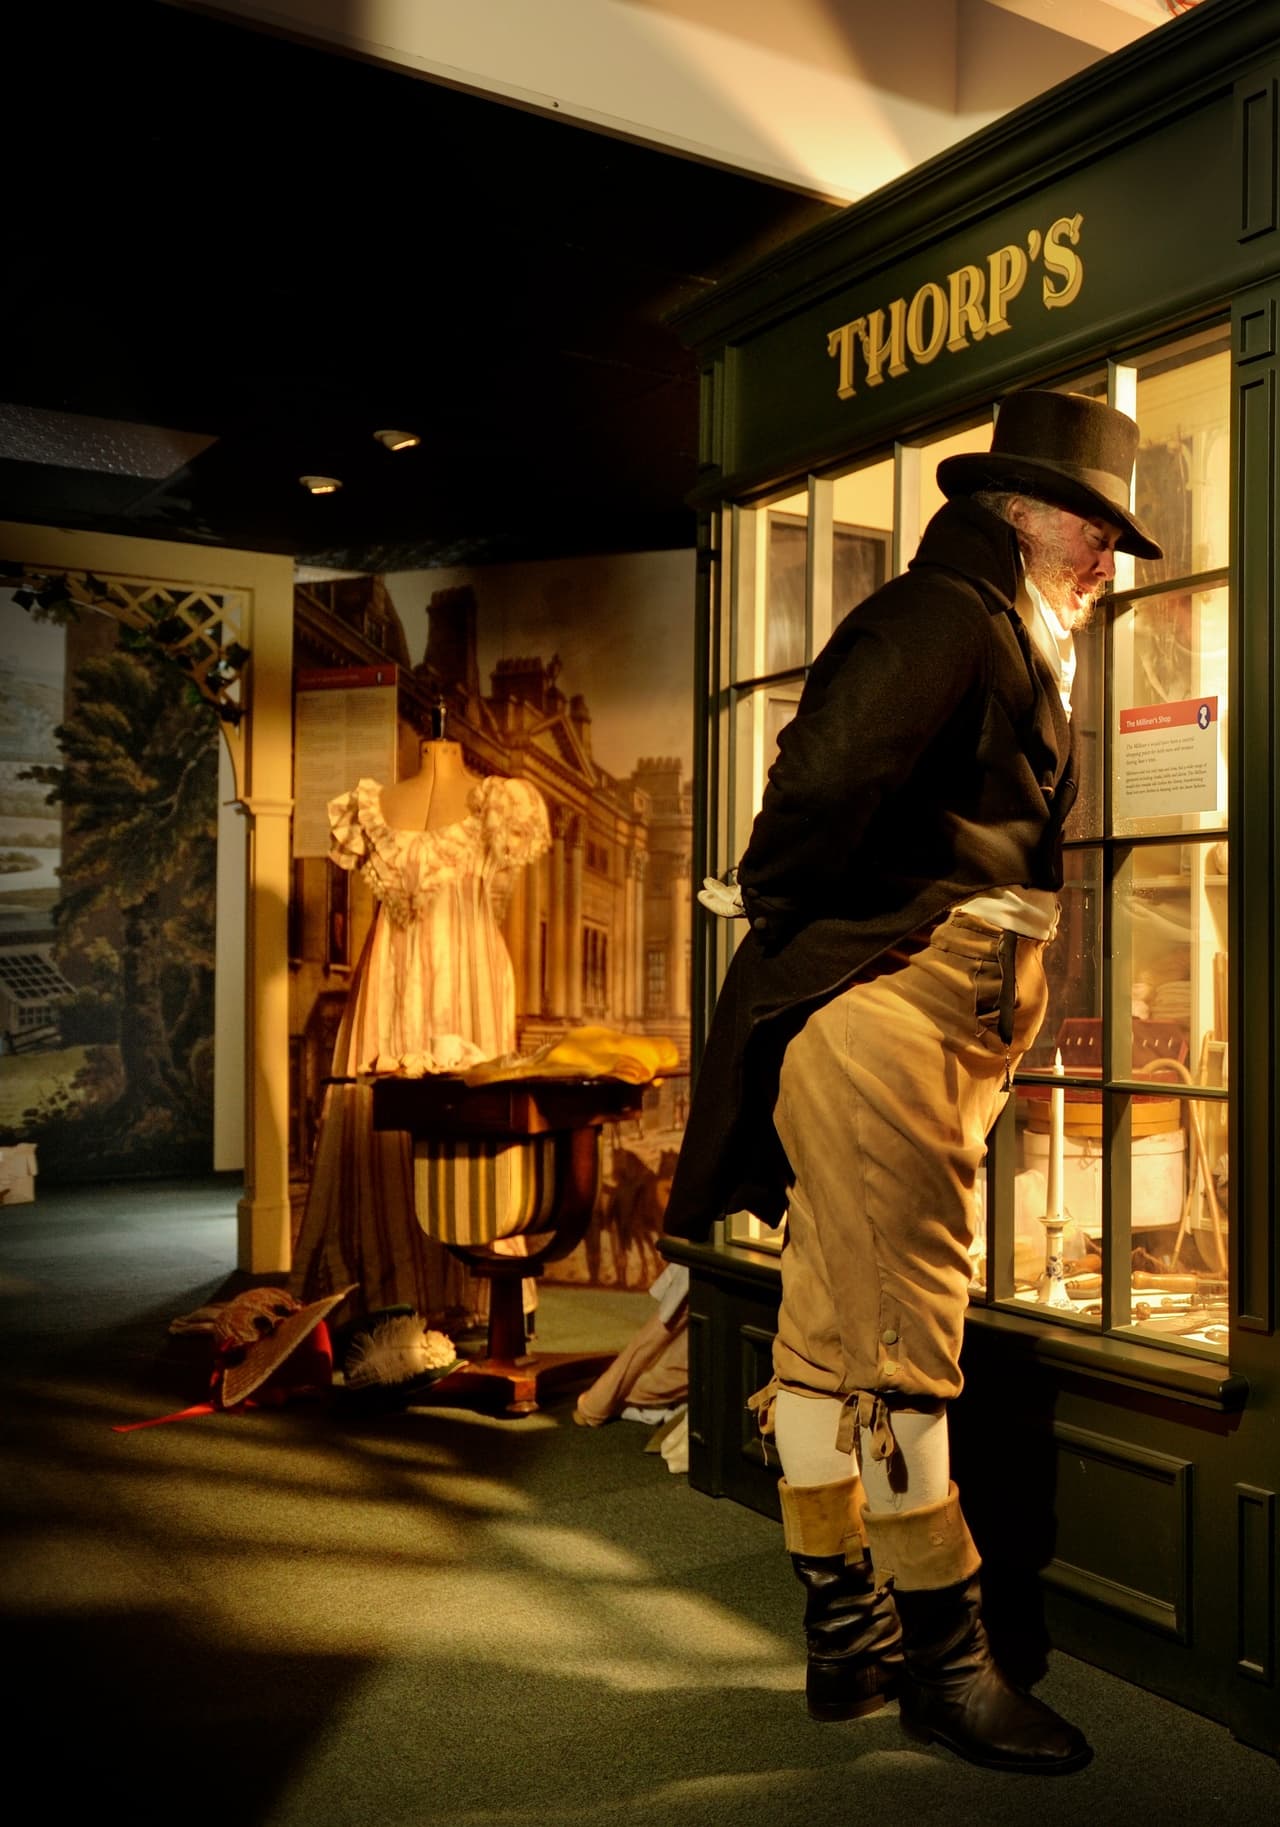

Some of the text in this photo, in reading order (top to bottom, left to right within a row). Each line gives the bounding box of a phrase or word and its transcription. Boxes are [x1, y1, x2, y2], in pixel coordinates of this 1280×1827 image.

[827, 213, 1084, 400] THORP'S
[1126, 720, 1135, 728] The
[1158, 715, 1171, 724] Shop
